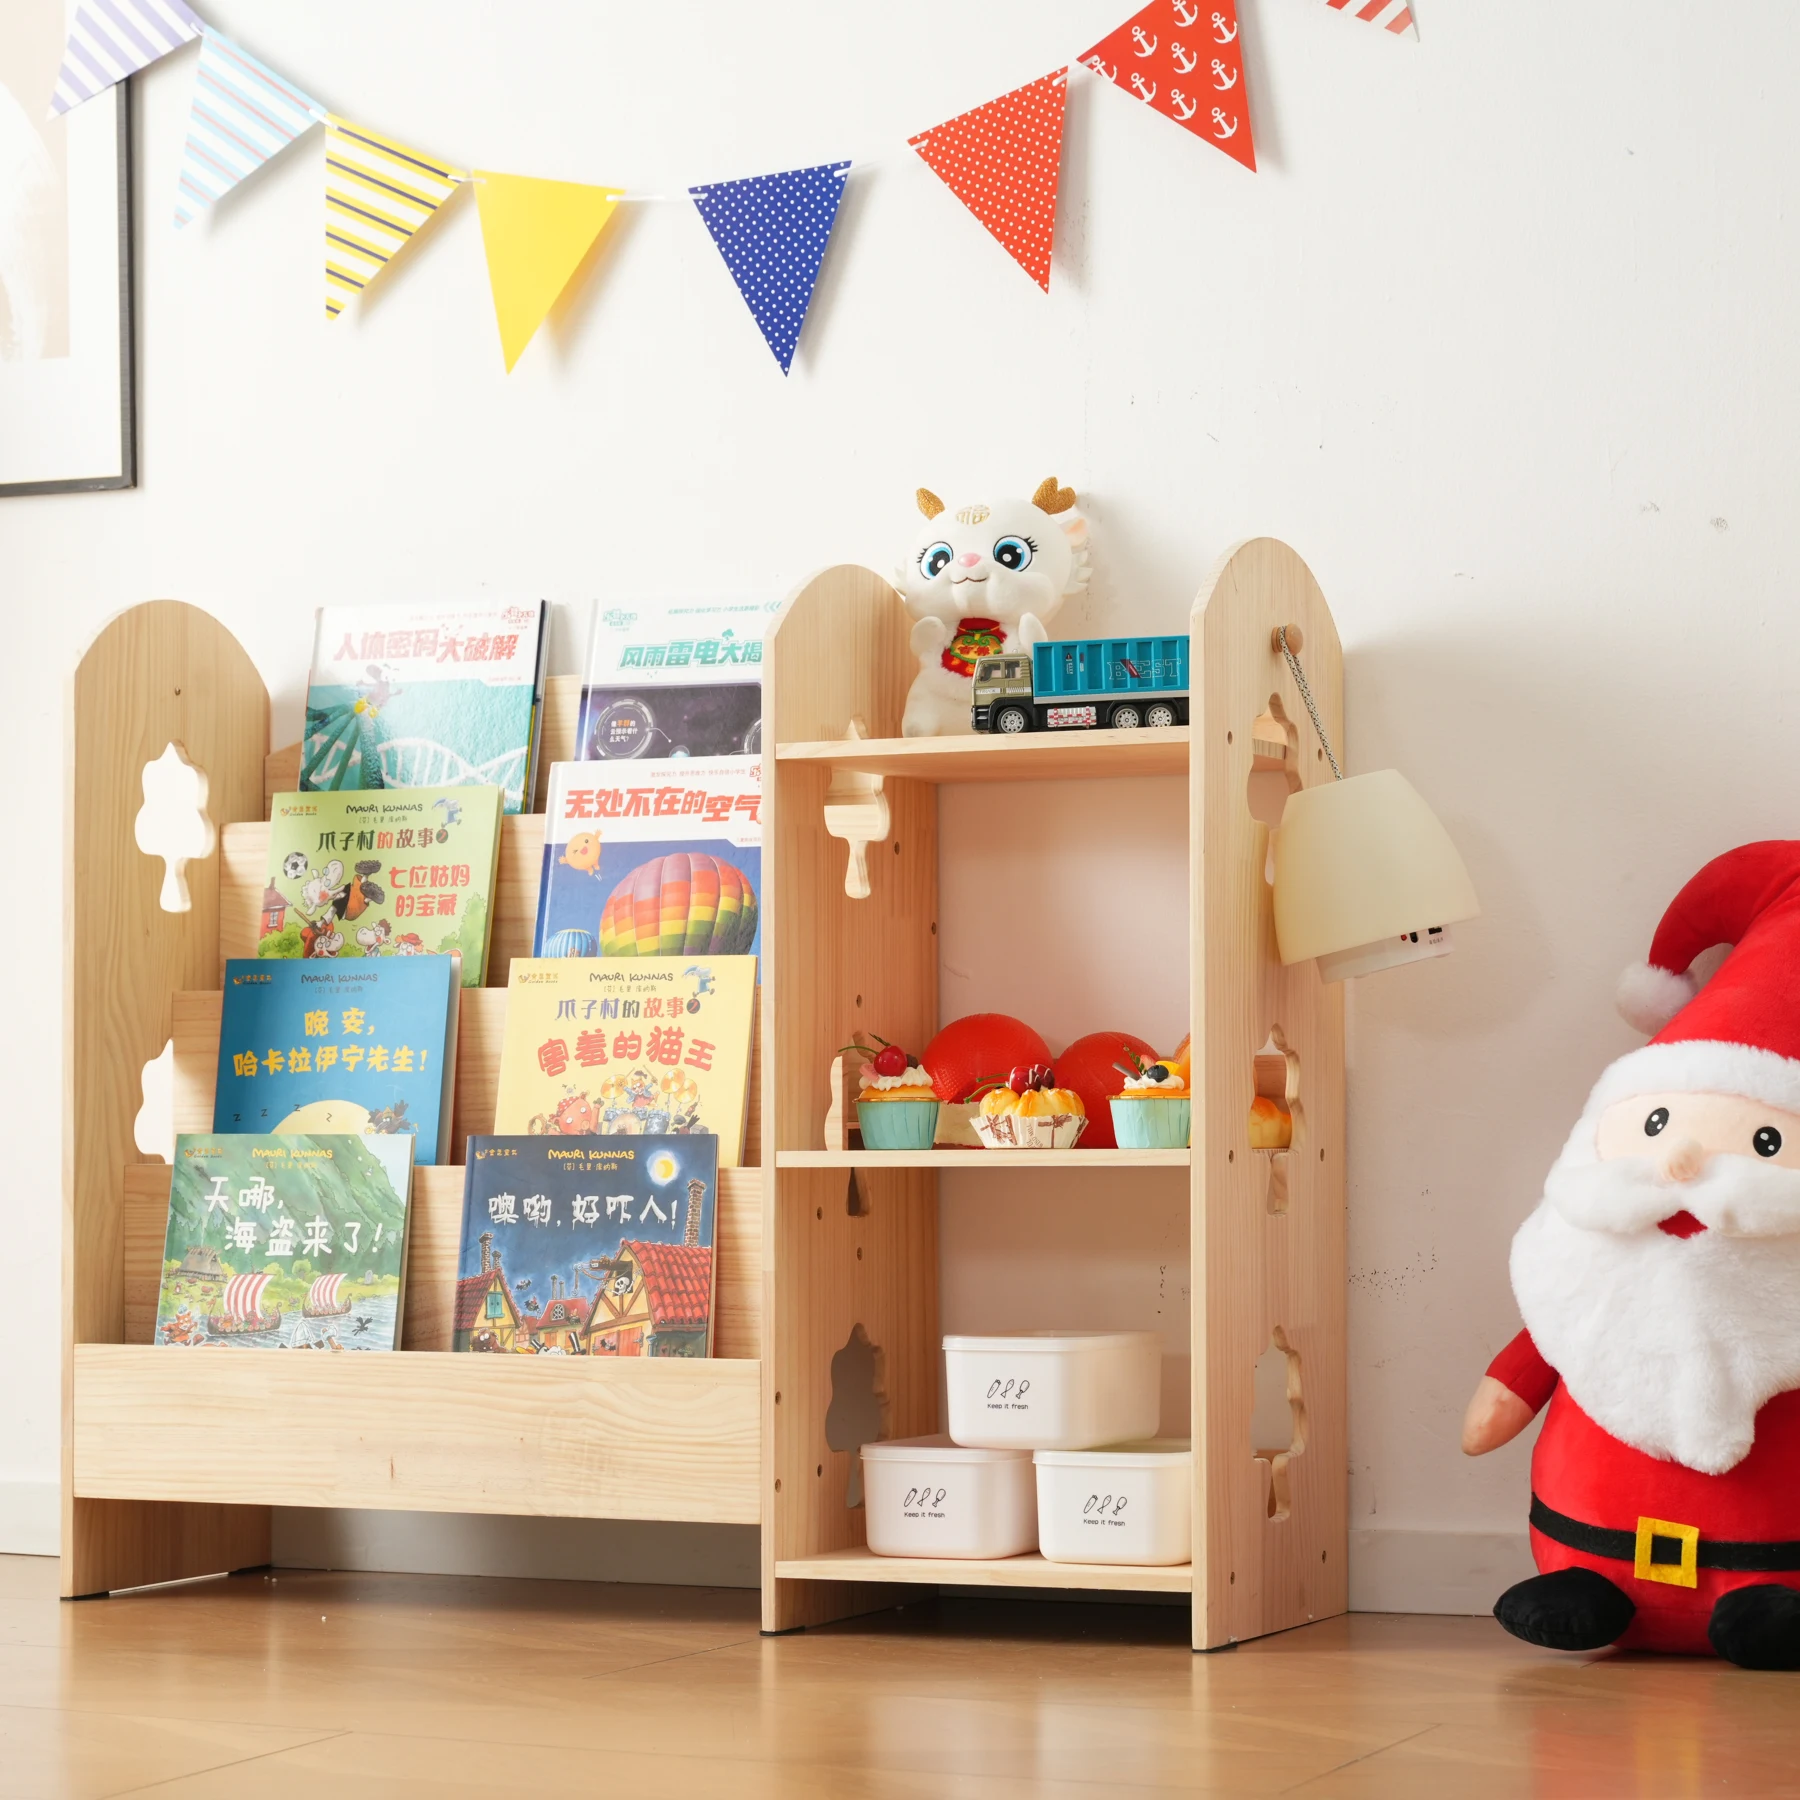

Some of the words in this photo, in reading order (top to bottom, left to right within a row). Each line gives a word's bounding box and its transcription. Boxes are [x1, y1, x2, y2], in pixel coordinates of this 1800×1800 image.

[333, 629, 520, 663] 人体密码大破解
[346, 804, 378, 814] MAURI
[383, 803, 423, 812] KUNNAS
[565, 786, 762, 822] 无处不在的空气
[316, 827, 433, 853] 爪子村的故事
[389, 864, 470, 888] 七位姑妈
[395, 893, 458, 917] 的宝藏
[301, 973, 334, 984] MAURI
[338, 973, 378, 983] KUNNAS
[589, 972, 625, 983] MAURI
[629, 972, 674, 982] KUNNAS
[555, 997, 684, 1021] 爪子村的故事
[304, 1007, 375, 1036] 晚安，
[233, 1044, 428, 1077] 哈卡拉伊宁先生！
[537, 1025, 716, 1077] 害羞的猫王
[252, 1147, 287, 1158] MAURI
[290, 1148, 333, 1159] KUNNAS
[548, 1149, 585, 1160] MAURI
[589, 1149, 635, 1160] KUNNAS
[204, 1176, 284, 1213] 天哪，
[224, 1215, 382, 1257] 海盗来了！
[904, 1511, 919, 1519] Keep
[1083, 1518, 1099, 1526] Keep
